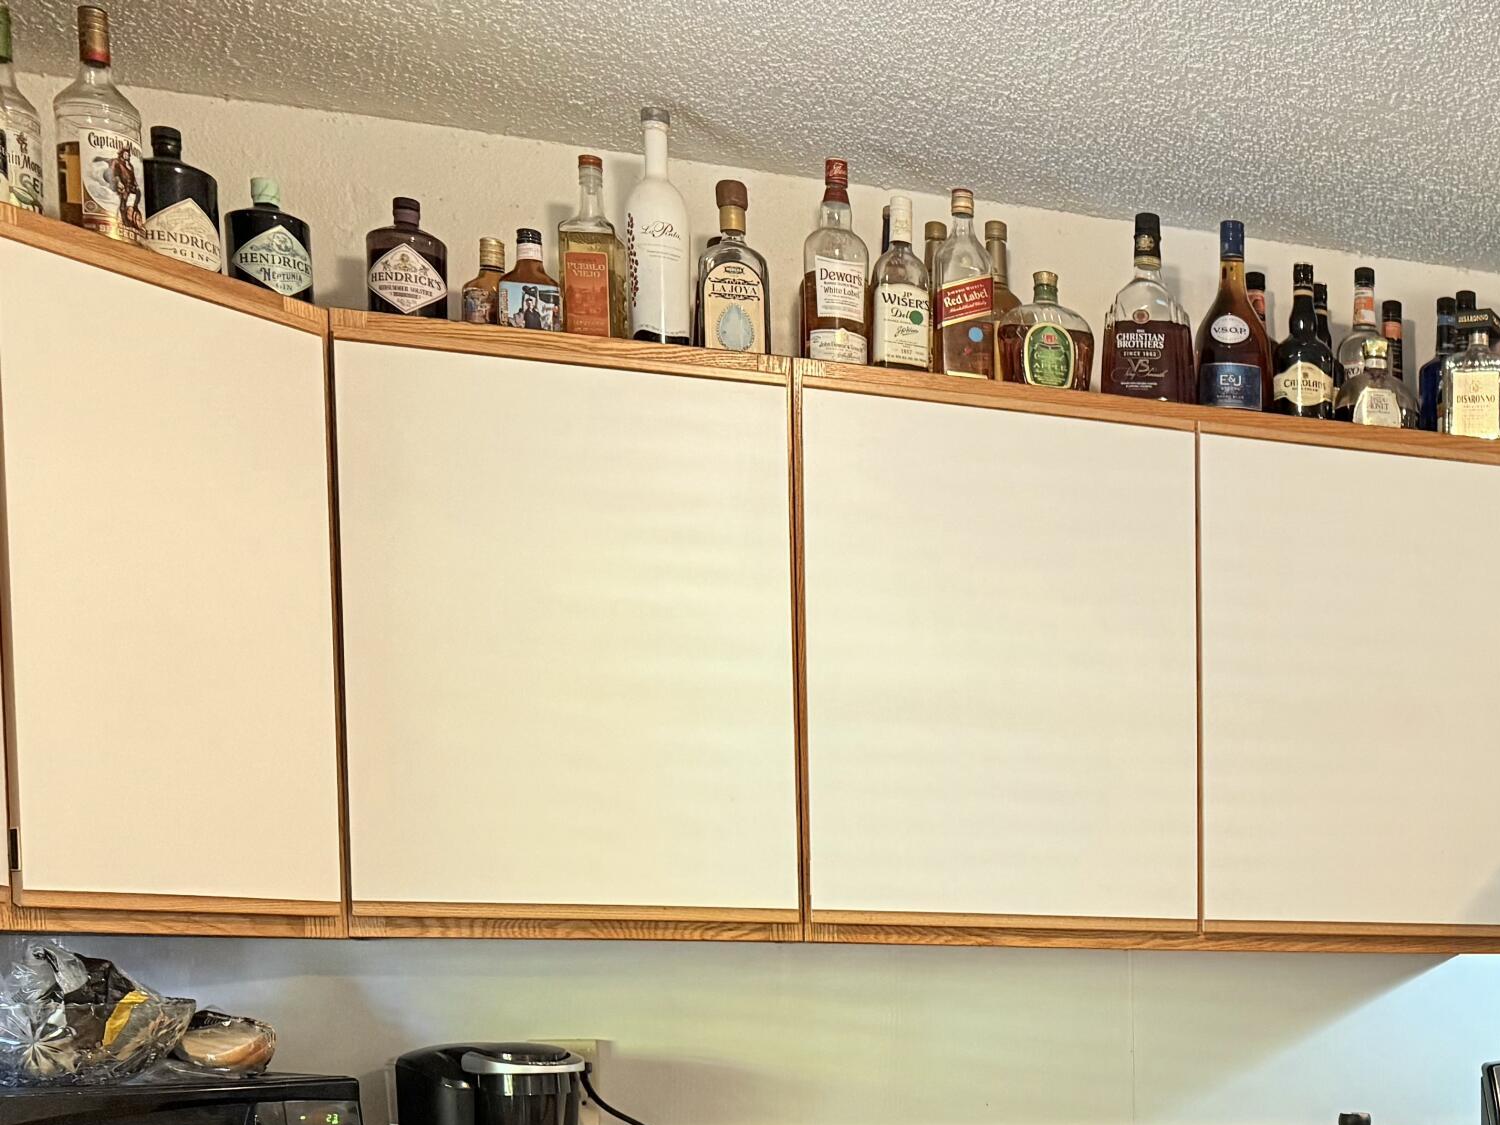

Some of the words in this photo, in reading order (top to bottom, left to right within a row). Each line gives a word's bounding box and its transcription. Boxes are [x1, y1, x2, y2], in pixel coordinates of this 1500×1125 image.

[88, 131, 124, 150] Captain
[145, 229, 220, 257] HENDRICK
[239, 252, 312, 276] HENDRICK
[371, 271, 441, 292] HENDRICK'S
[572, 269, 601, 278] VIEJO
[820, 267, 863, 287] Dewar's
[729, 283, 758, 295] JOYA
[824, 286, 842, 294] White
[943, 294, 963, 307] Red
[963, 287, 989, 302] Label
[881, 292, 930, 311] WISER'S
[1116, 332, 1165, 342] CHRISTIAN
[1116, 340, 1165, 349] BROTHERS
[1220, 374, 1242, 387] E&J
[1283, 379, 1326, 391] CAOLANS
